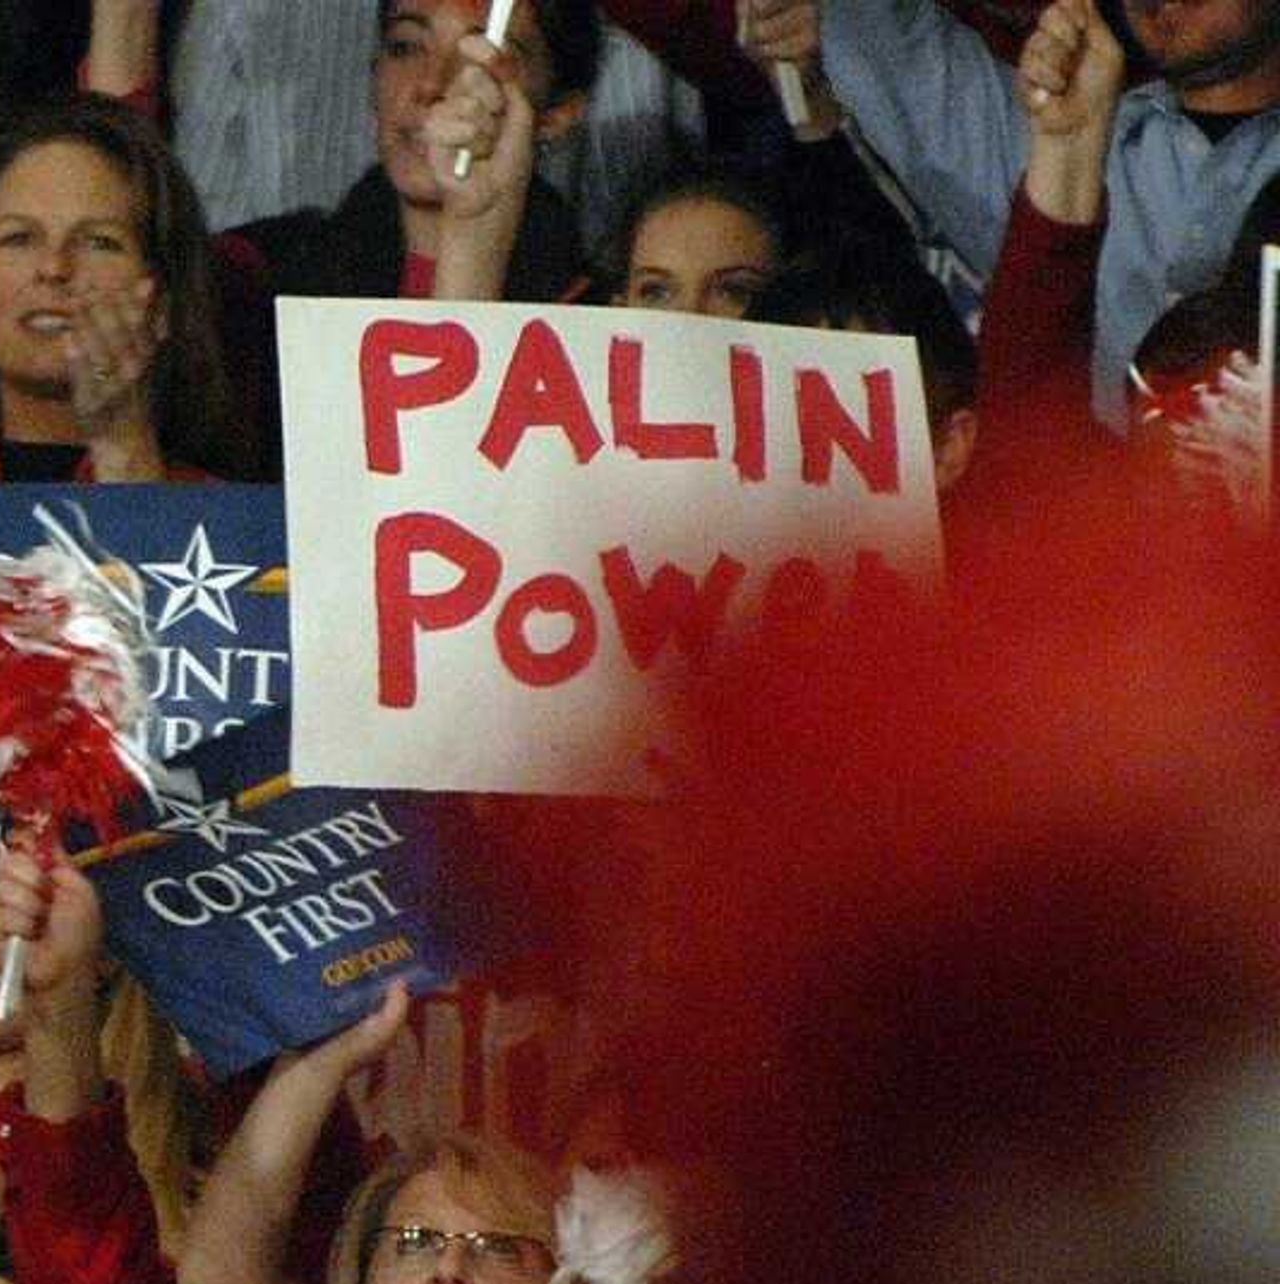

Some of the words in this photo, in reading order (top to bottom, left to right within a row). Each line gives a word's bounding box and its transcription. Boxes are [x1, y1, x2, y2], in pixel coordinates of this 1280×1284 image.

[358, 317, 901, 497] PALIN
[144, 801, 405, 927] COUNTRY
[243, 869, 399, 964] FIRST
